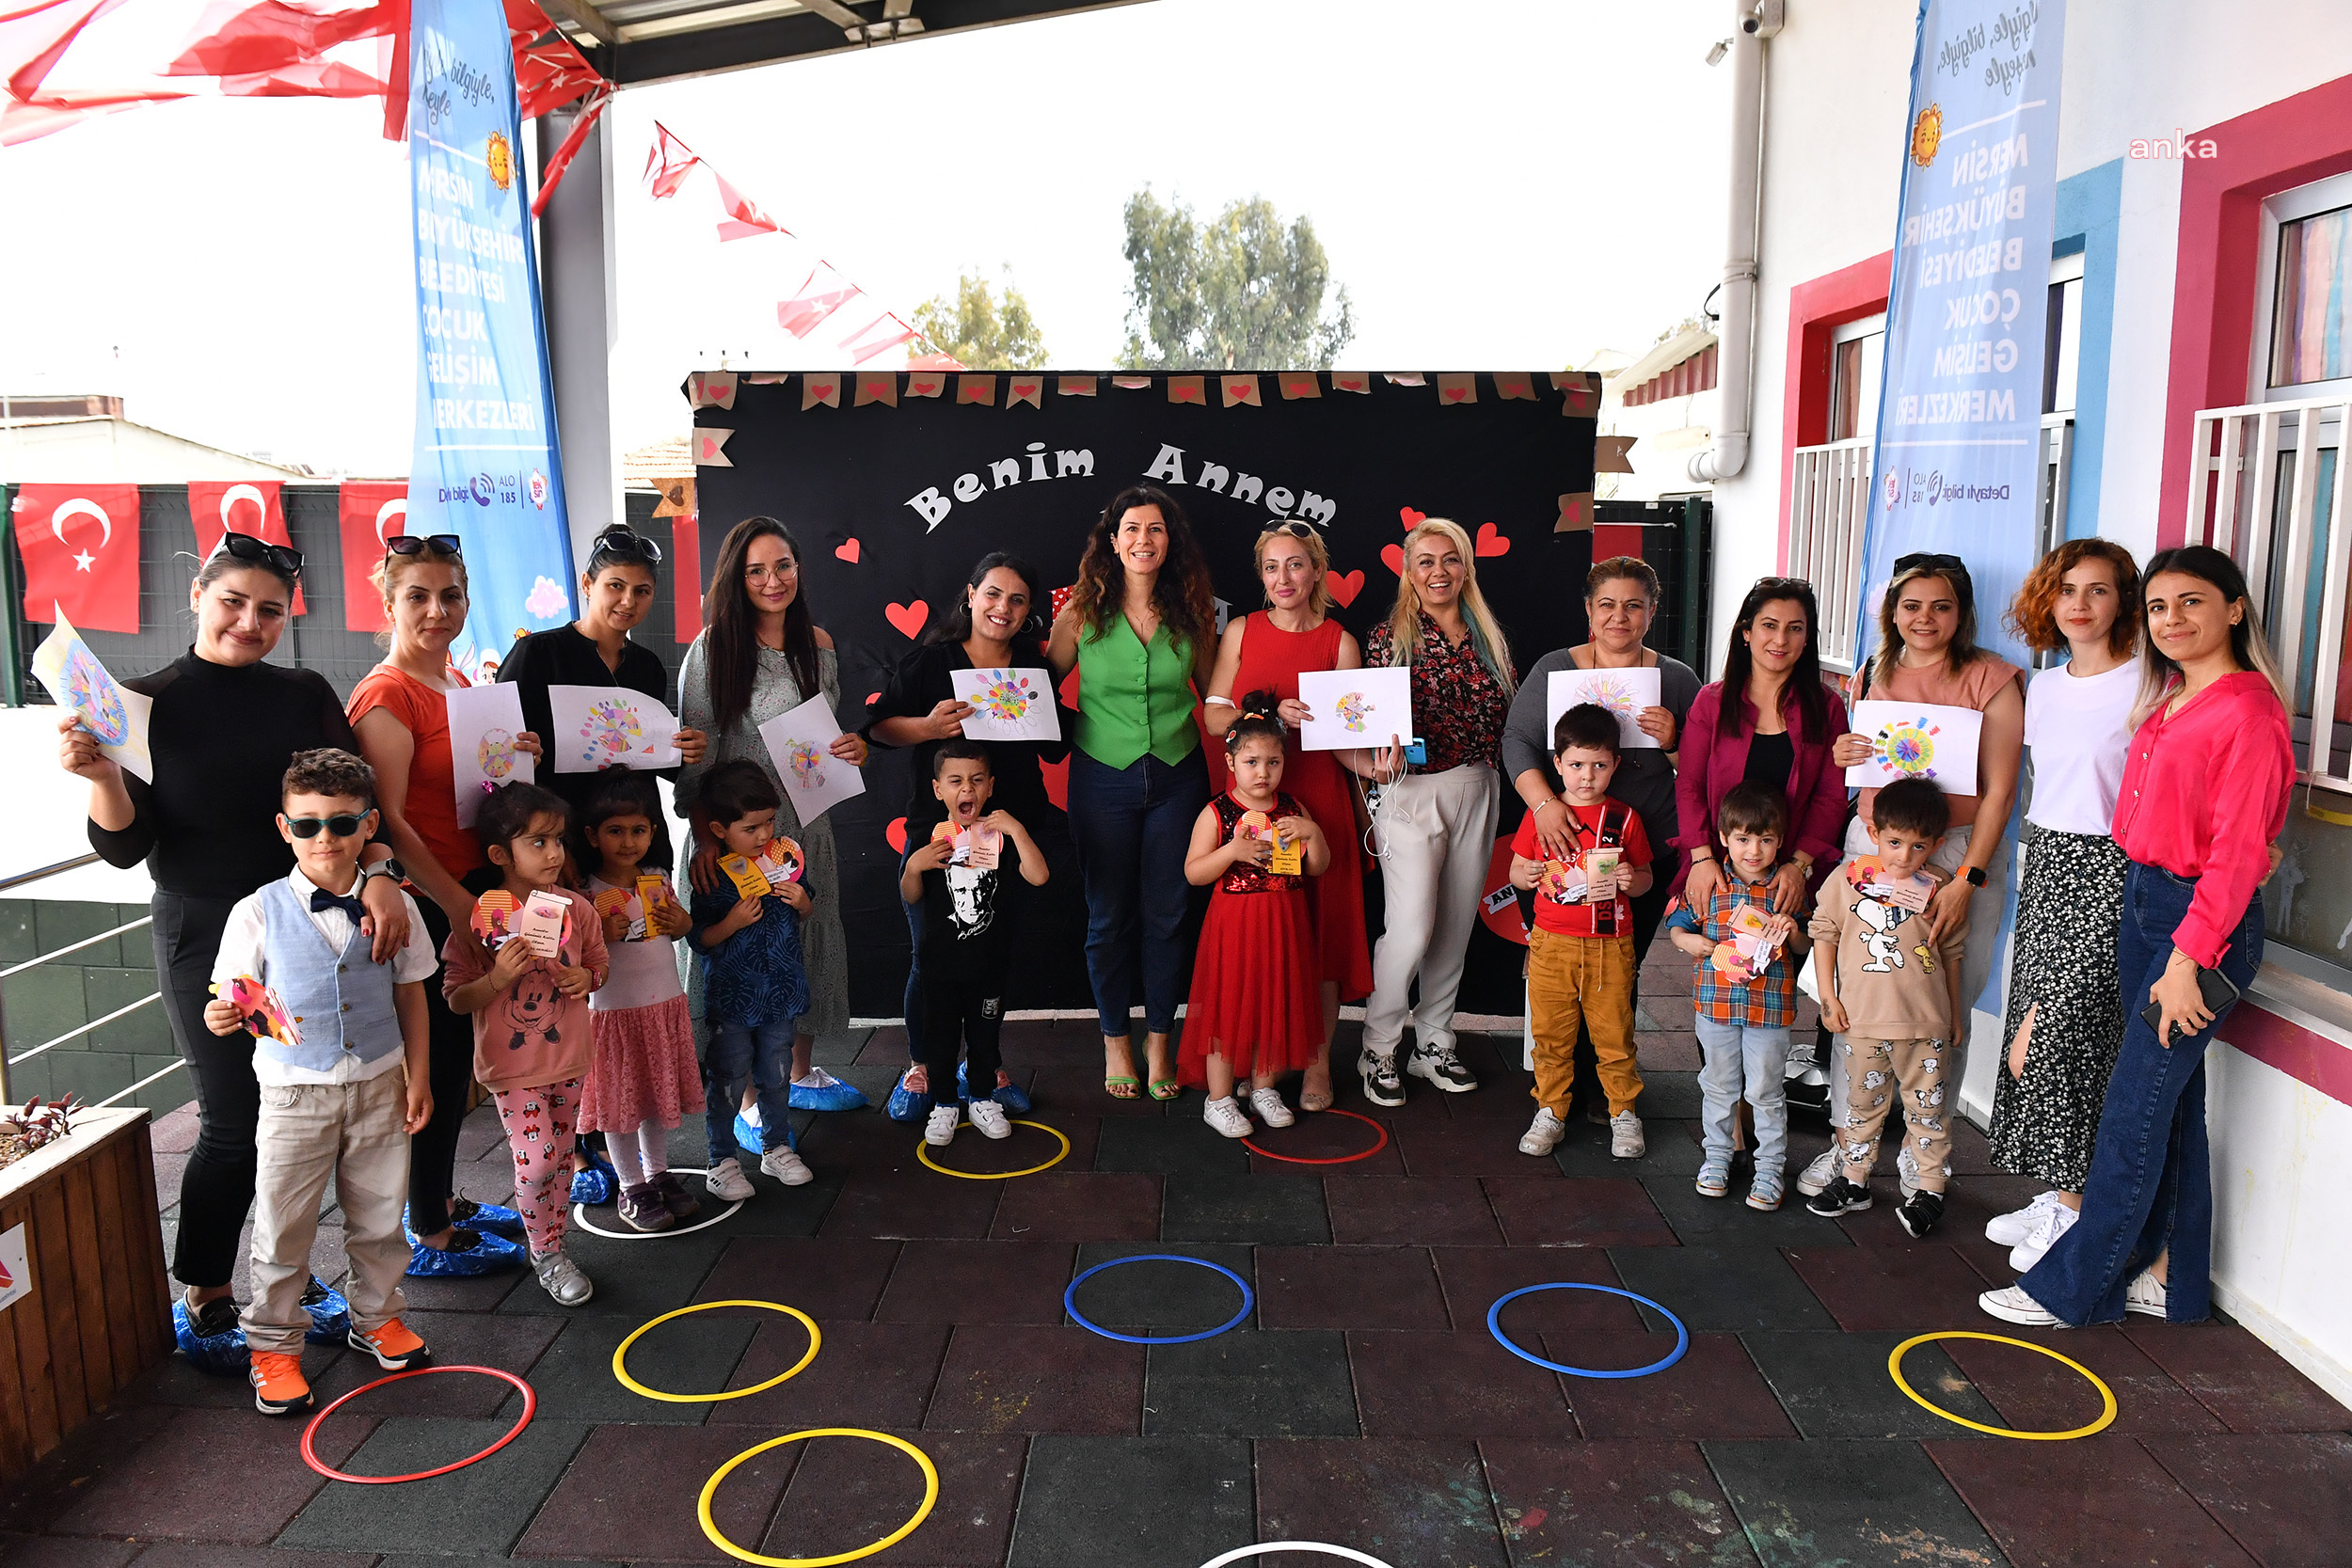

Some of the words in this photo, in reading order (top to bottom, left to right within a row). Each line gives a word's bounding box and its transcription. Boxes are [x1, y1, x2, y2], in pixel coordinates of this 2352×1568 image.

[451, 57, 495, 107] bilgiyle,
[418, 206, 527, 264] BYÜKŞEHİR
[419, 255, 506, 304] BEEDİYESİ
[432, 393, 537, 432] ERKEZLERİ
[499, 474, 516, 487] ALO
[501, 491, 516, 504] 185
[904, 442, 1096, 535] Benim
[1140, 443, 1338, 527] Annem
